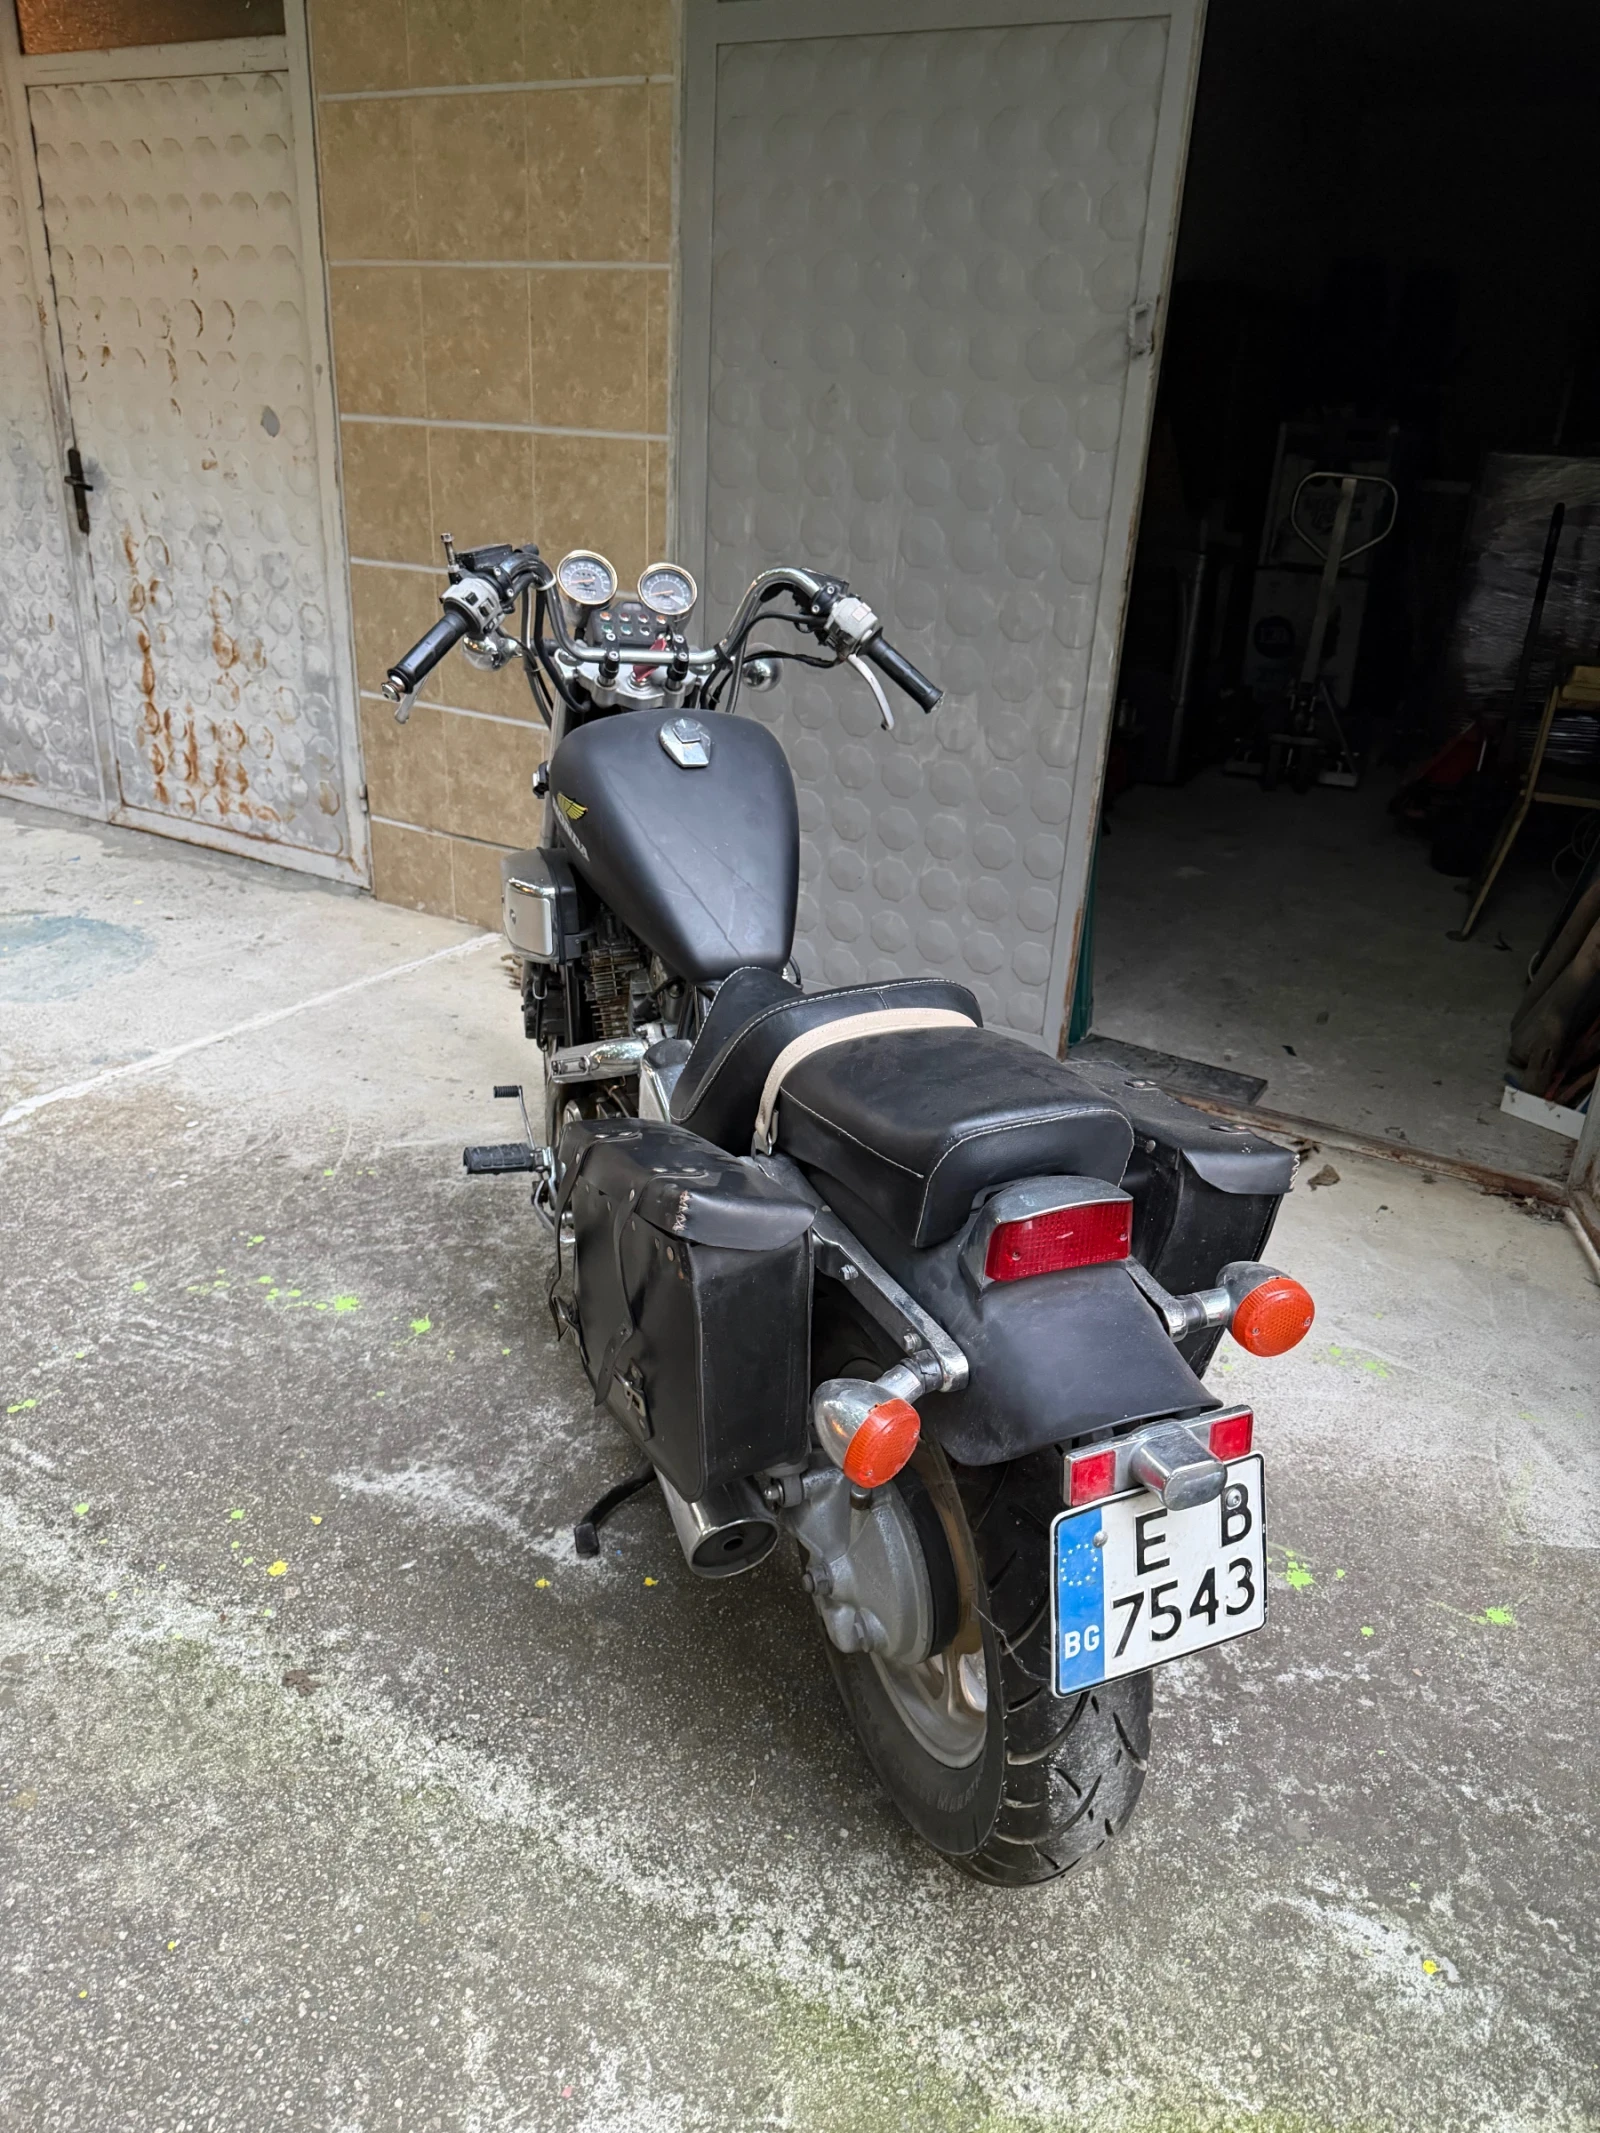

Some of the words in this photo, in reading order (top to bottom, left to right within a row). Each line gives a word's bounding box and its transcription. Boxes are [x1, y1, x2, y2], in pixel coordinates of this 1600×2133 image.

[1136, 1508, 1171, 1576] E
[1221, 1483, 1253, 1547] B
[1064, 1625, 1100, 1659] BG
[1111, 1557, 1255, 1658] 7543
